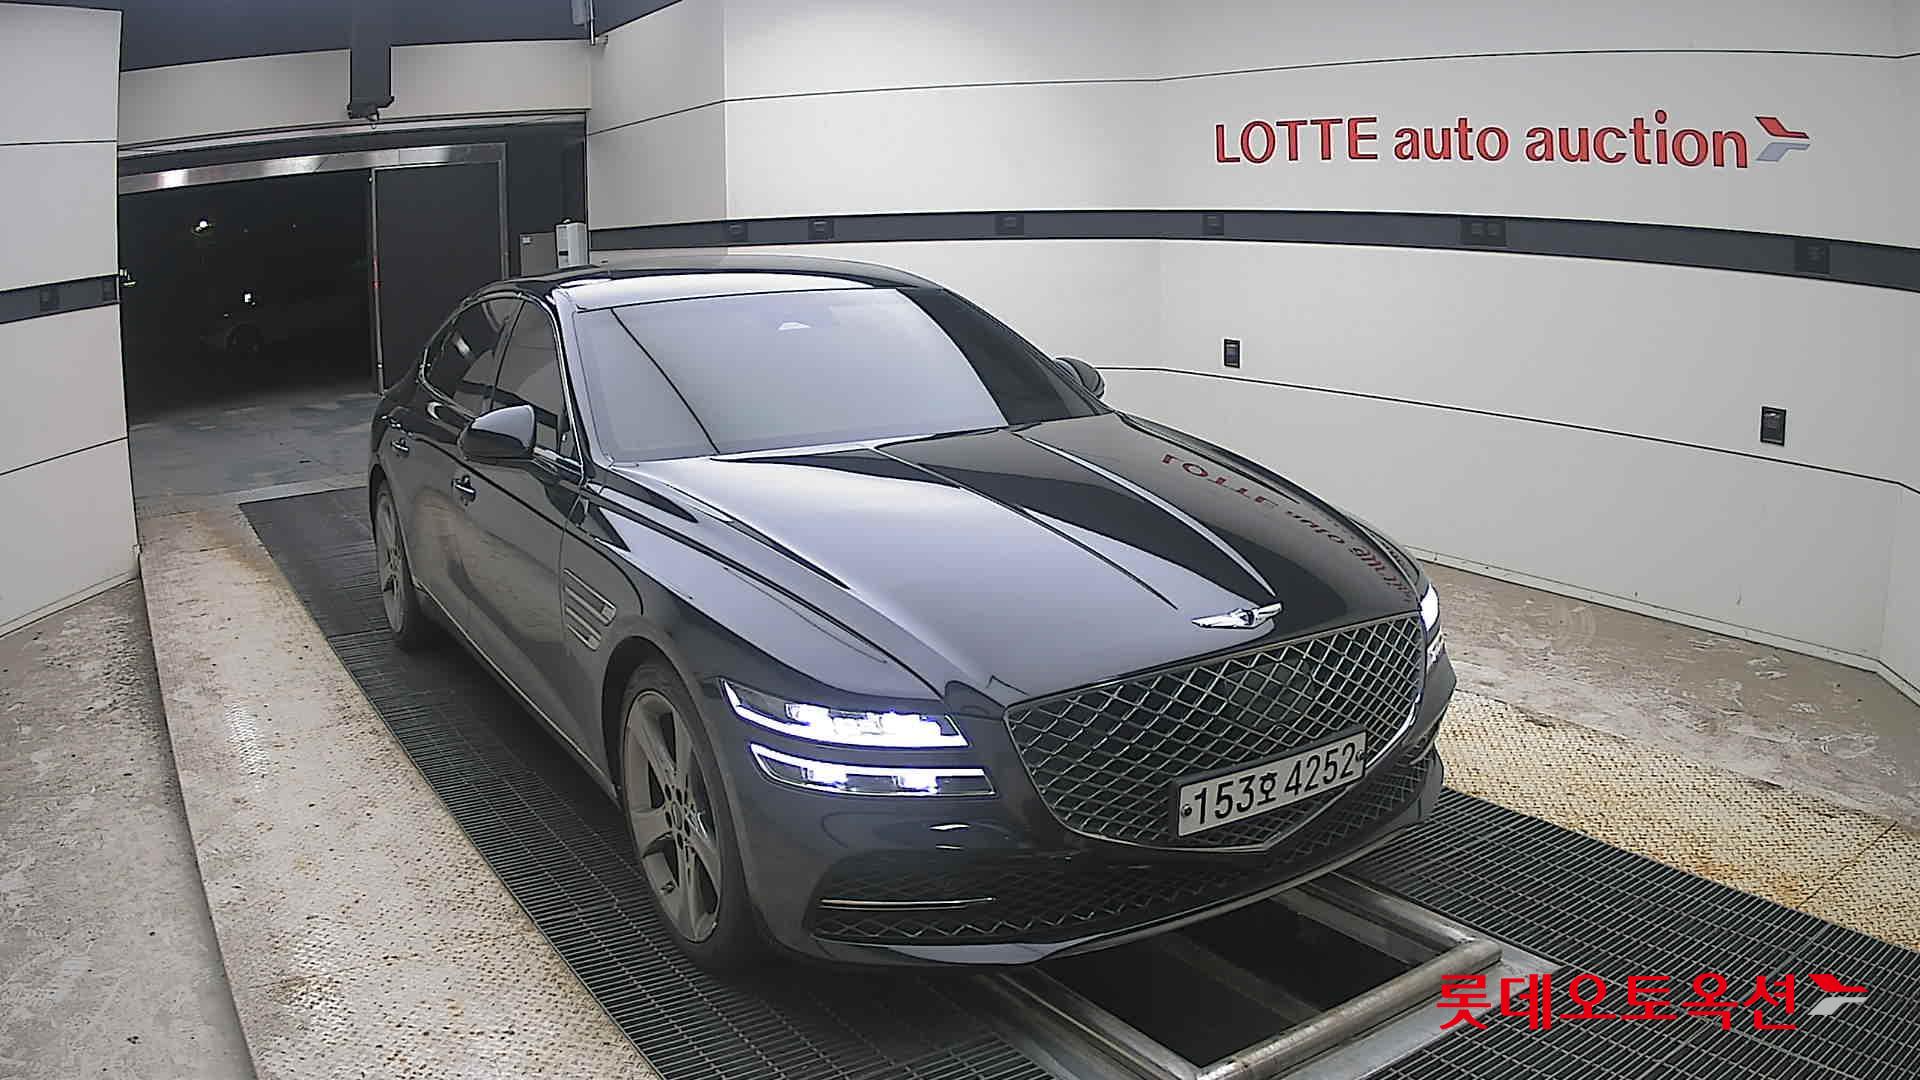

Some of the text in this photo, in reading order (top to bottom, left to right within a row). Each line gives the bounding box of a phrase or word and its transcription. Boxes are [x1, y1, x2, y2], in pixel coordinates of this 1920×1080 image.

[1215, 110, 1749, 168] LOTTE auto auction
[1194, 742, 1356, 825] 153호 4252
